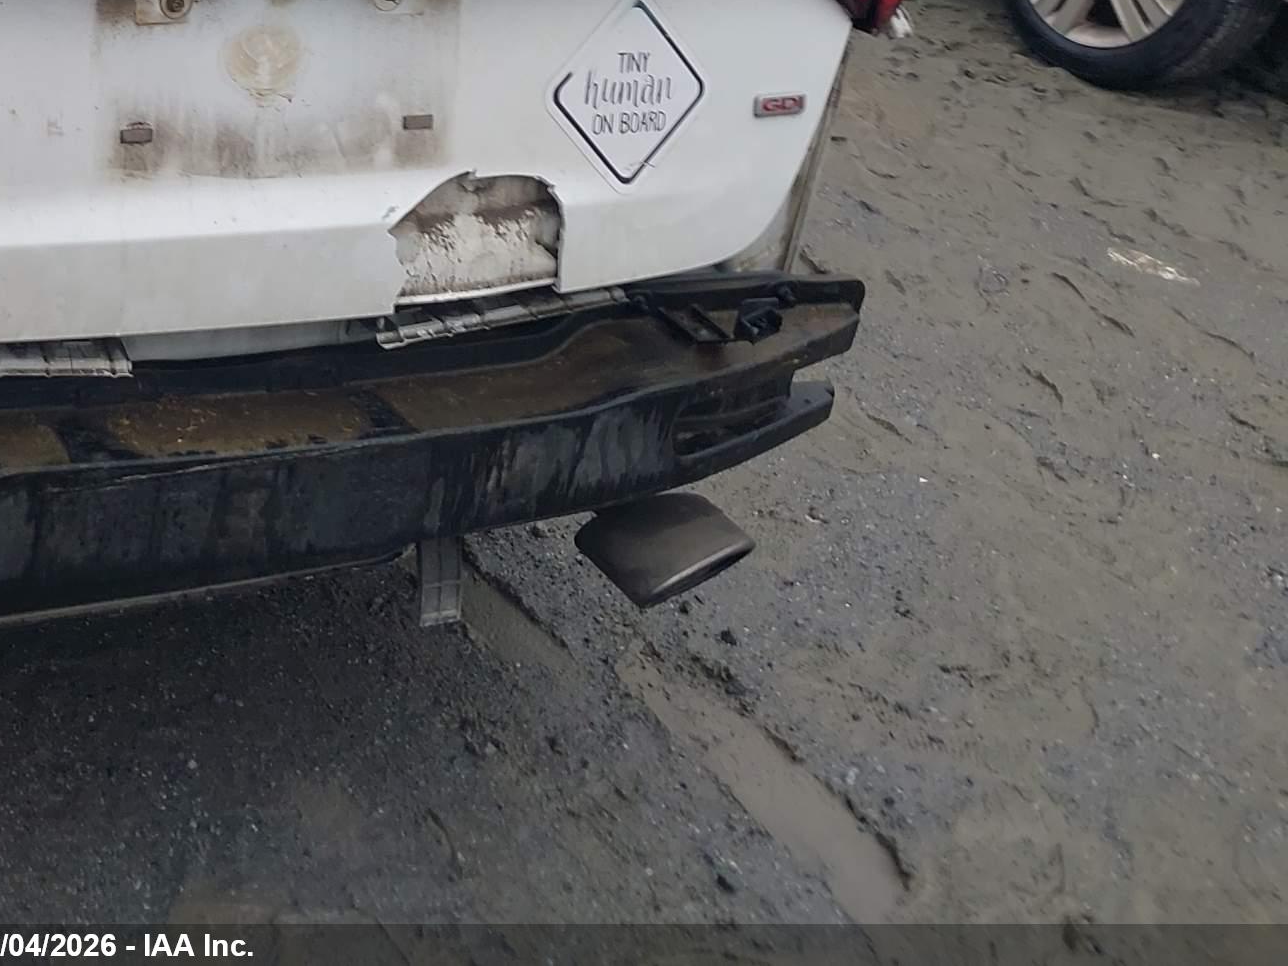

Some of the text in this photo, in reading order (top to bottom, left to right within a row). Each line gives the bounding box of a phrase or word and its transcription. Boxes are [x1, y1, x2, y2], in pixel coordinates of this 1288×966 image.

[618, 52, 651, 74] TINY
[584, 71, 673, 110] human
[592, 111, 667, 135] ON BOARD
